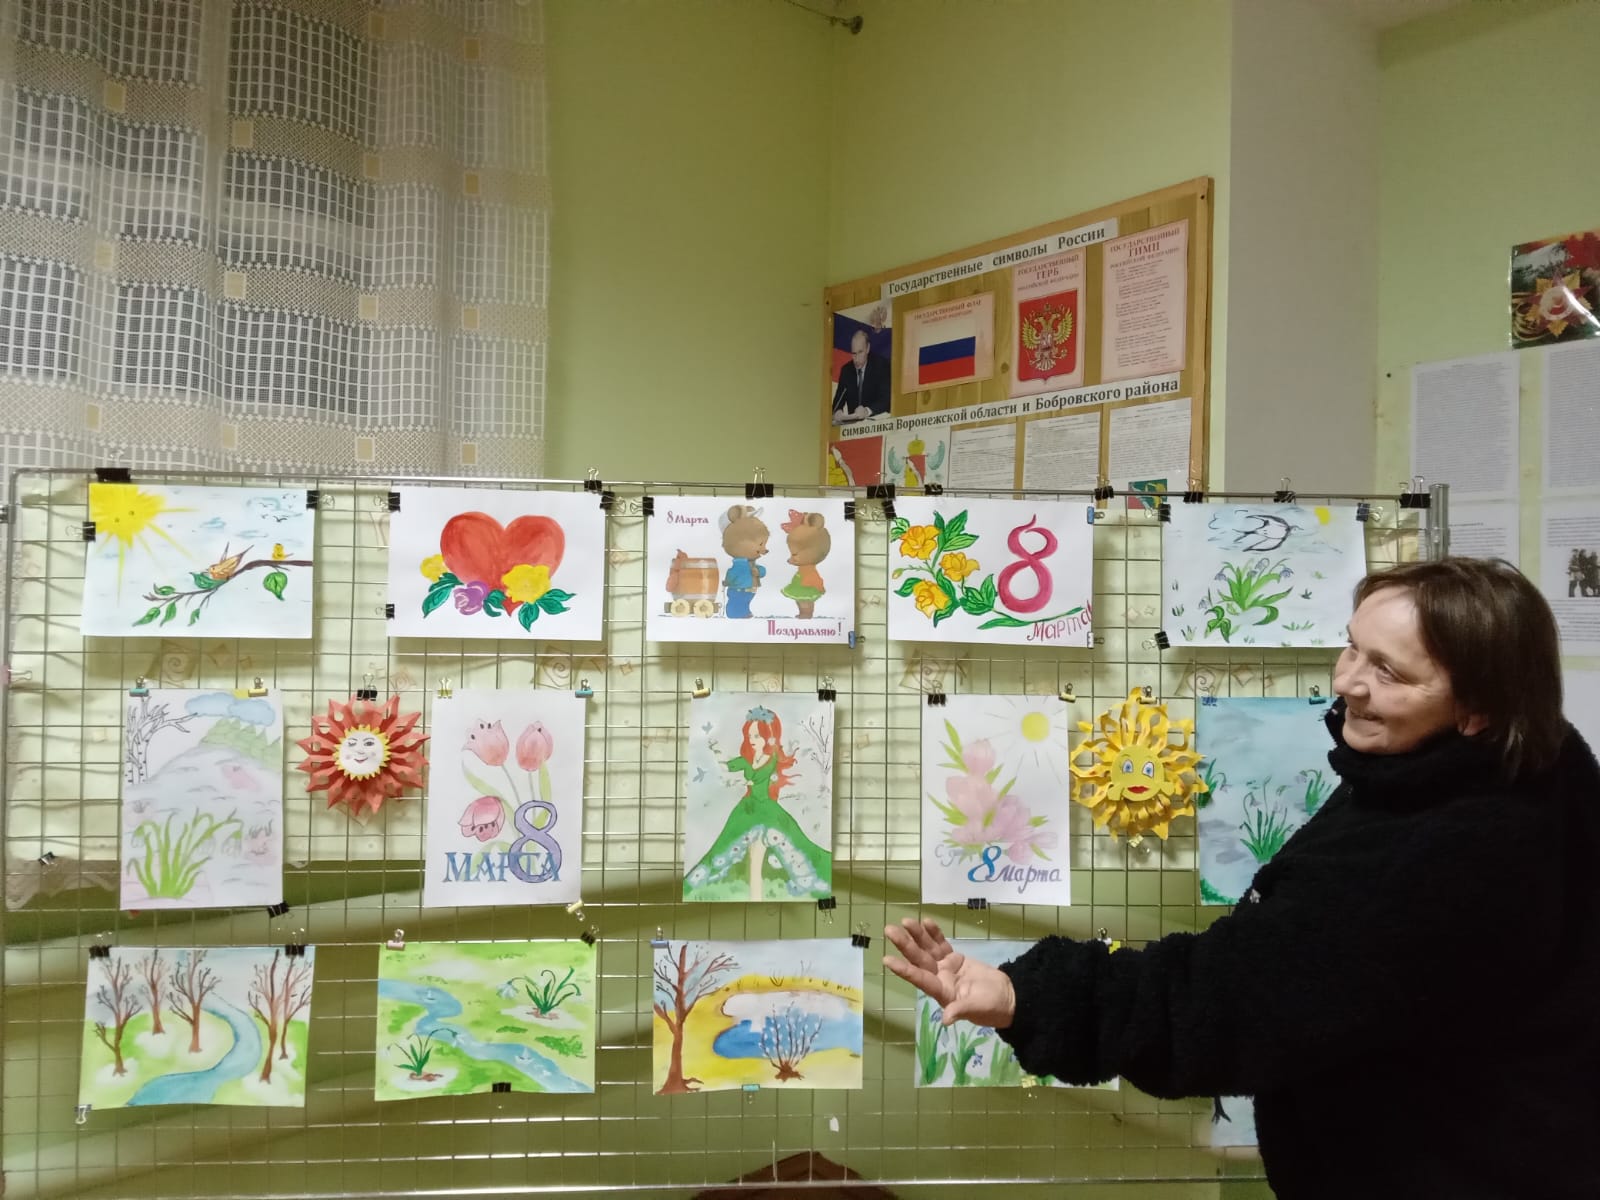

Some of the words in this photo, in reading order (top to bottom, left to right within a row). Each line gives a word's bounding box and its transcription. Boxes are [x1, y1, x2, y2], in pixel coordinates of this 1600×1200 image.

[888, 260, 984, 295] Государственные
[992, 243, 1048, 267] символы
[1058, 227, 1105, 249] России
[1036, 267, 1059, 280] ГЕРБ
[841, 421, 894, 437] символика
[896, 407, 968, 432] Воронежской
[970, 402, 1018, 419] области
[1022, 402, 1031, 412] и
[1035, 387, 1121, 411] Бобровского
[1125, 379, 1179, 400] района
[666, 510, 674, 524] 8
[997, 513, 1059, 614] 8
[508, 800, 562, 883] 8
[967, 845, 1002, 883] 8
